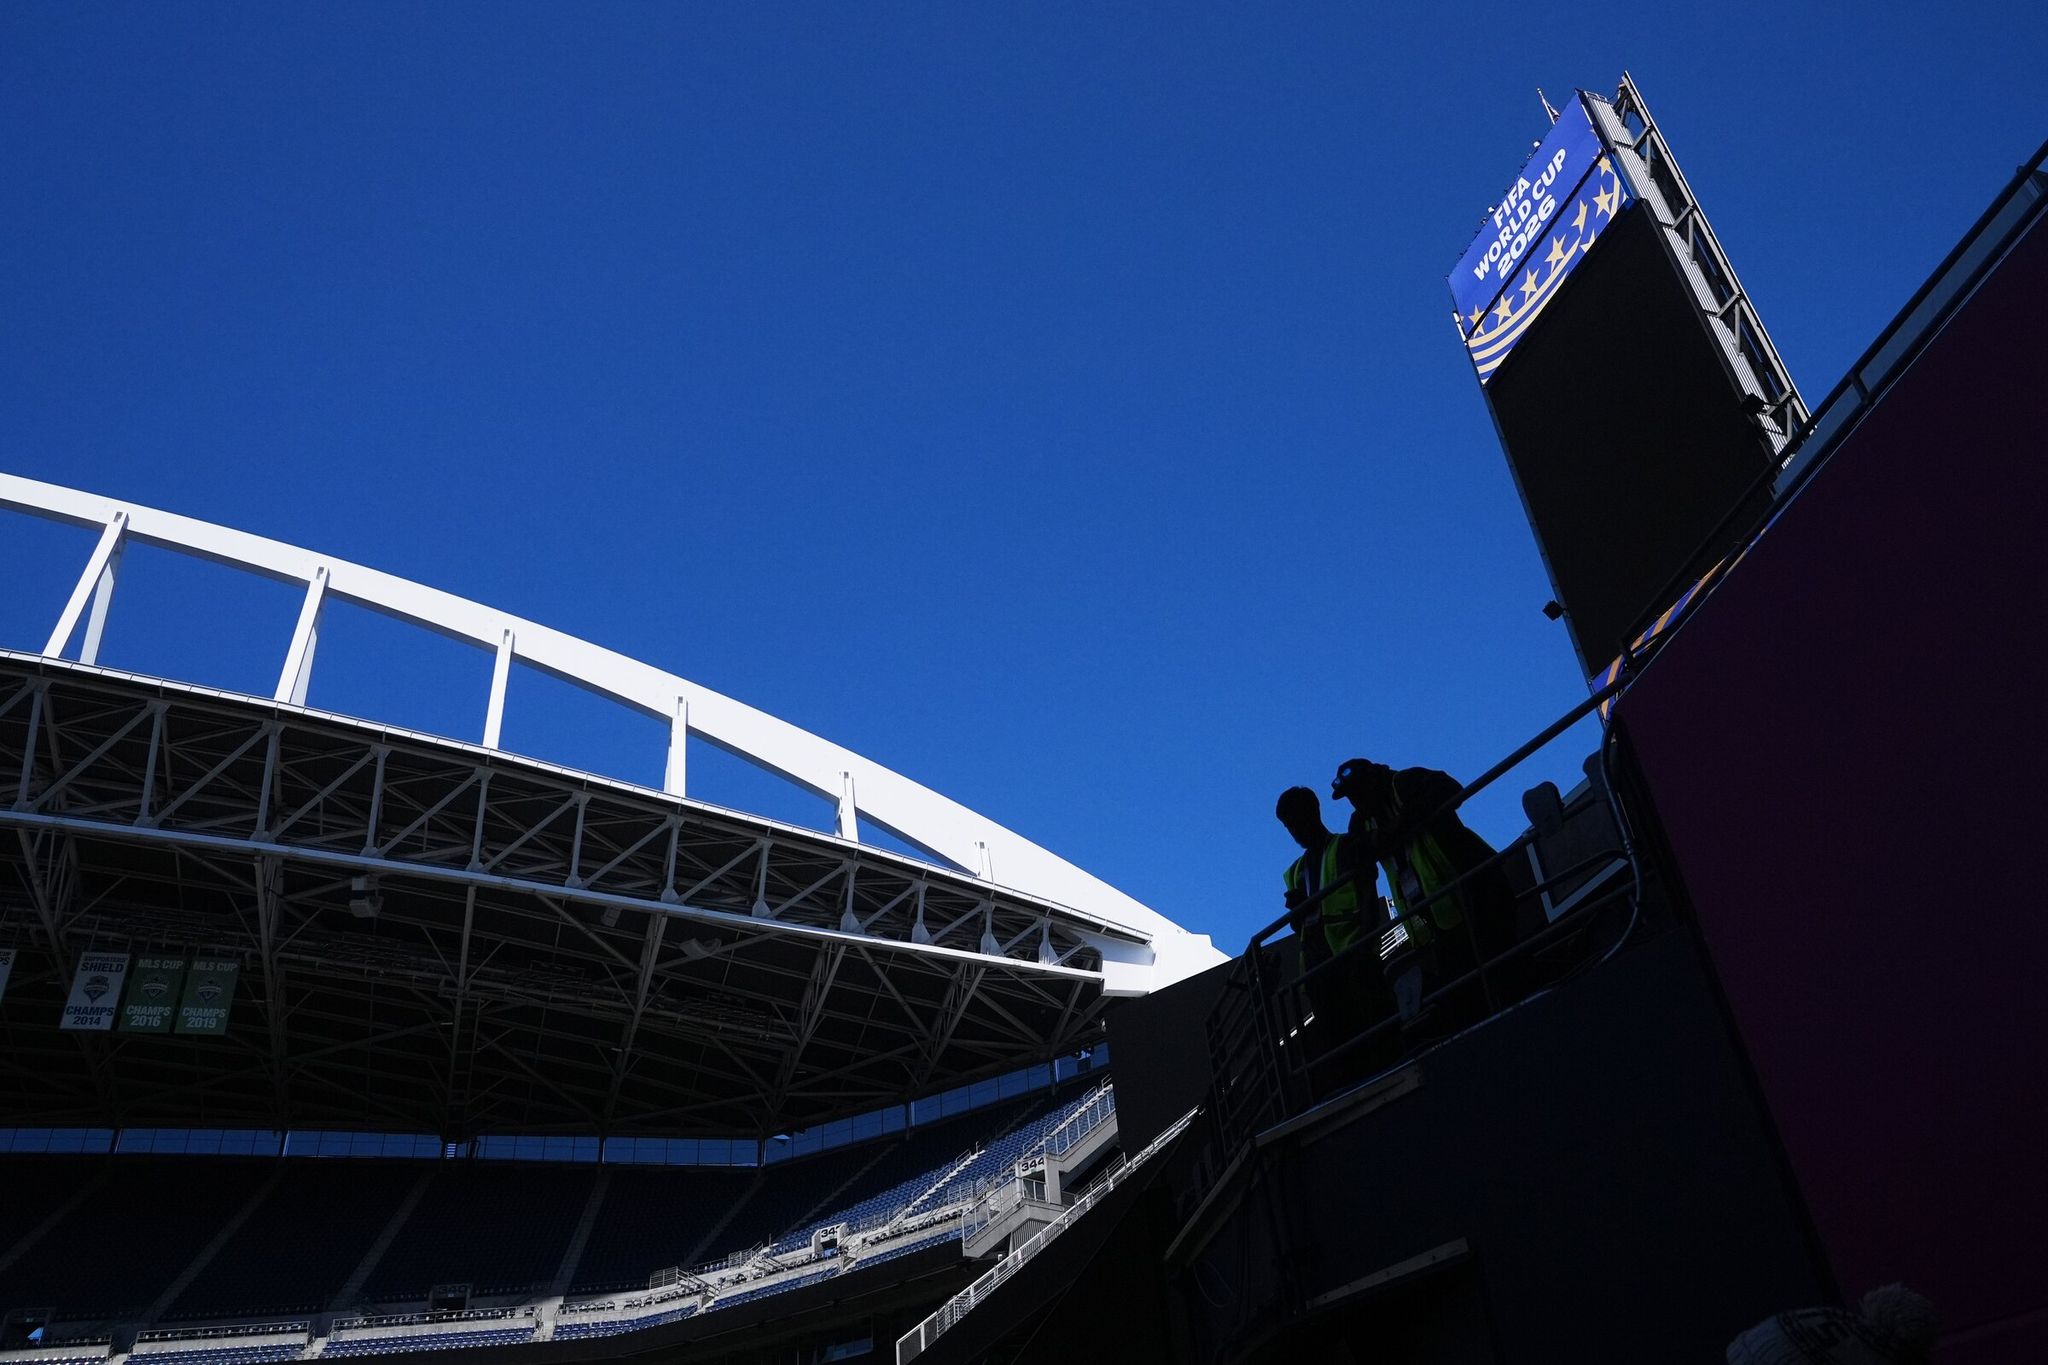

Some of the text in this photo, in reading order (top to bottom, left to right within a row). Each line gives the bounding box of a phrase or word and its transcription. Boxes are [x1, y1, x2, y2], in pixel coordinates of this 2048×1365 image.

[1493, 177, 1531, 229] FIFA
[1473, 148, 1567, 281] WORLD CUP
[1497, 194, 1556, 280] 2026
[80, 962, 125, 973] SHIELD
[138, 958, 186, 970] MLS CUP
[192, 961, 239, 972] MLS CUP
[65, 1005, 114, 1016] CHAMPS
[126, 1005, 172, 1017] CHAMPS
[182, 1007, 227, 1018] CHAMPS
[72, 1016, 101, 1025] 2014
[130, 1015, 162, 1027] 2016
[185, 1017, 217, 1029] 2019
[1022, 1157, 1044, 1171] 344
